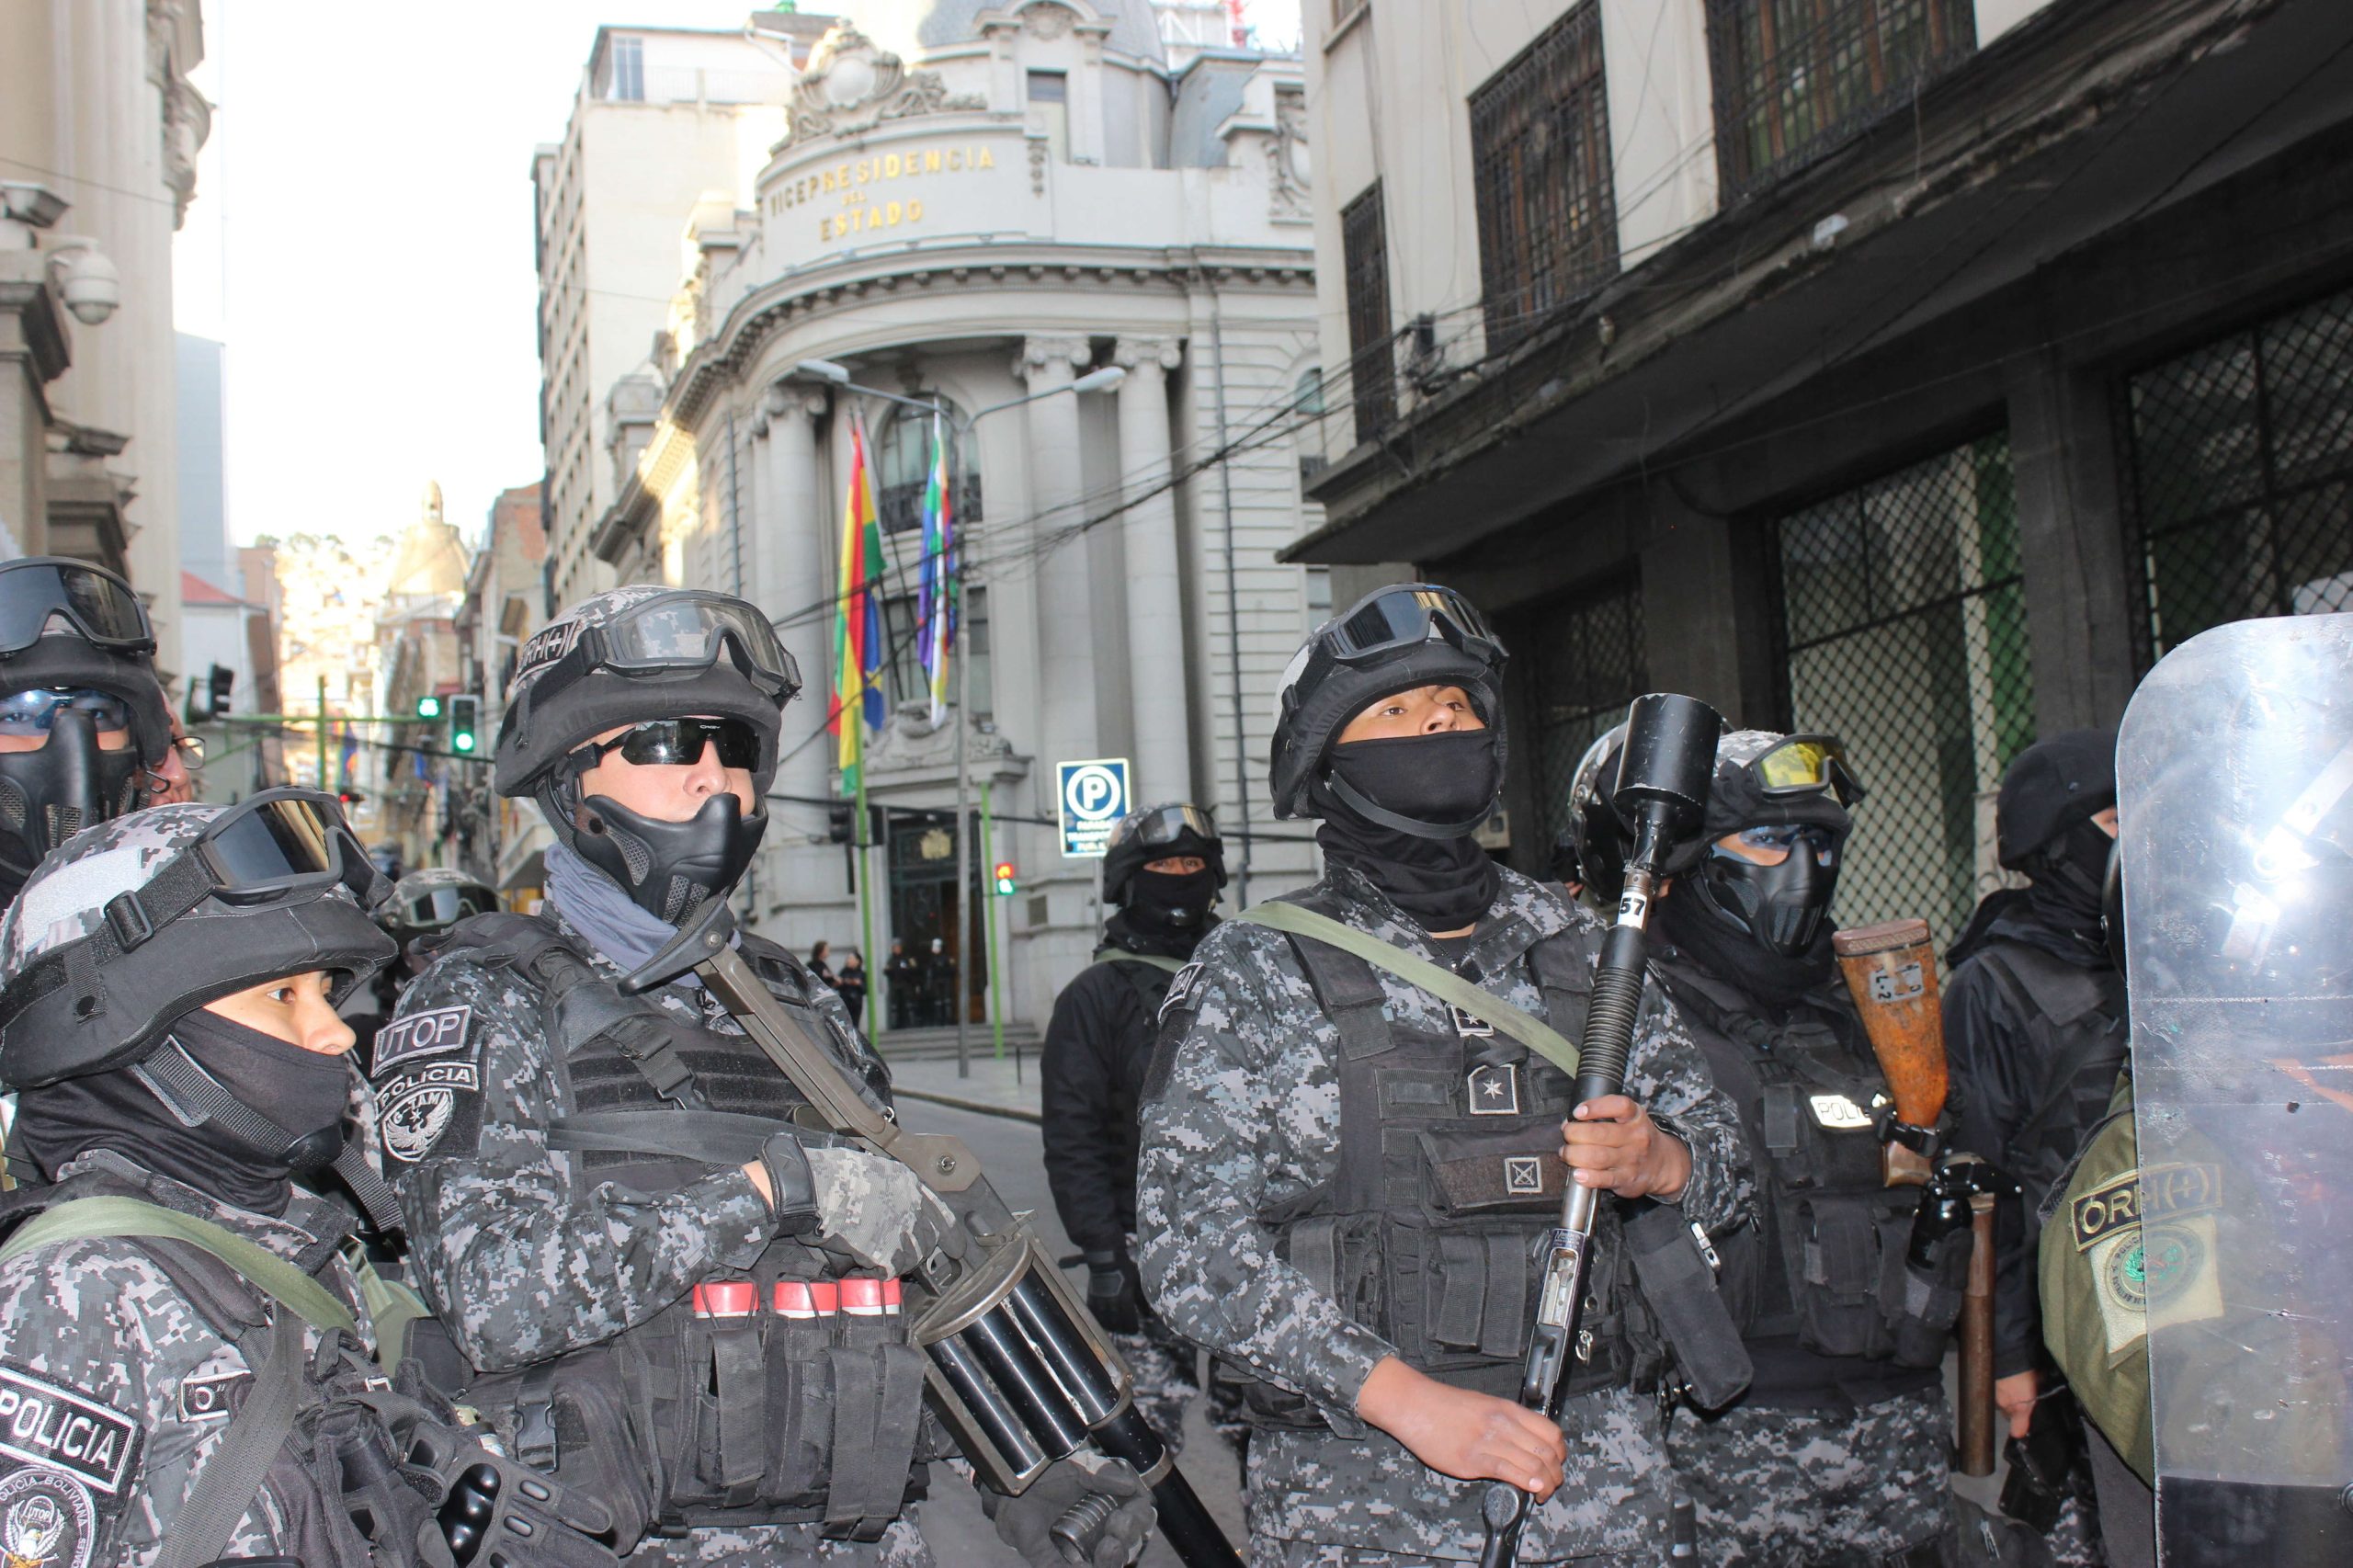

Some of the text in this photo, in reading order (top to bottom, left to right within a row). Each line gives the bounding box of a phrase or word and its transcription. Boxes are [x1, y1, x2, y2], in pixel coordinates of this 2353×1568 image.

[771, 146, 995, 216] VICEPRESIDENCIA
[842, 190, 867, 205] DEL
[820, 199, 924, 242] ESTADO
[1083, 776, 1108, 811] P
[1620, 897, 1645, 916] 57
[377, 1013, 460, 1062] UTOP
[381, 1068, 472, 1108] POLICIA
[1817, 1102, 1862, 1121] POLI
[0, 1476, 89, 1528] OLICIA BOLIVIANA
[29, 1506, 51, 1521] UTOP
